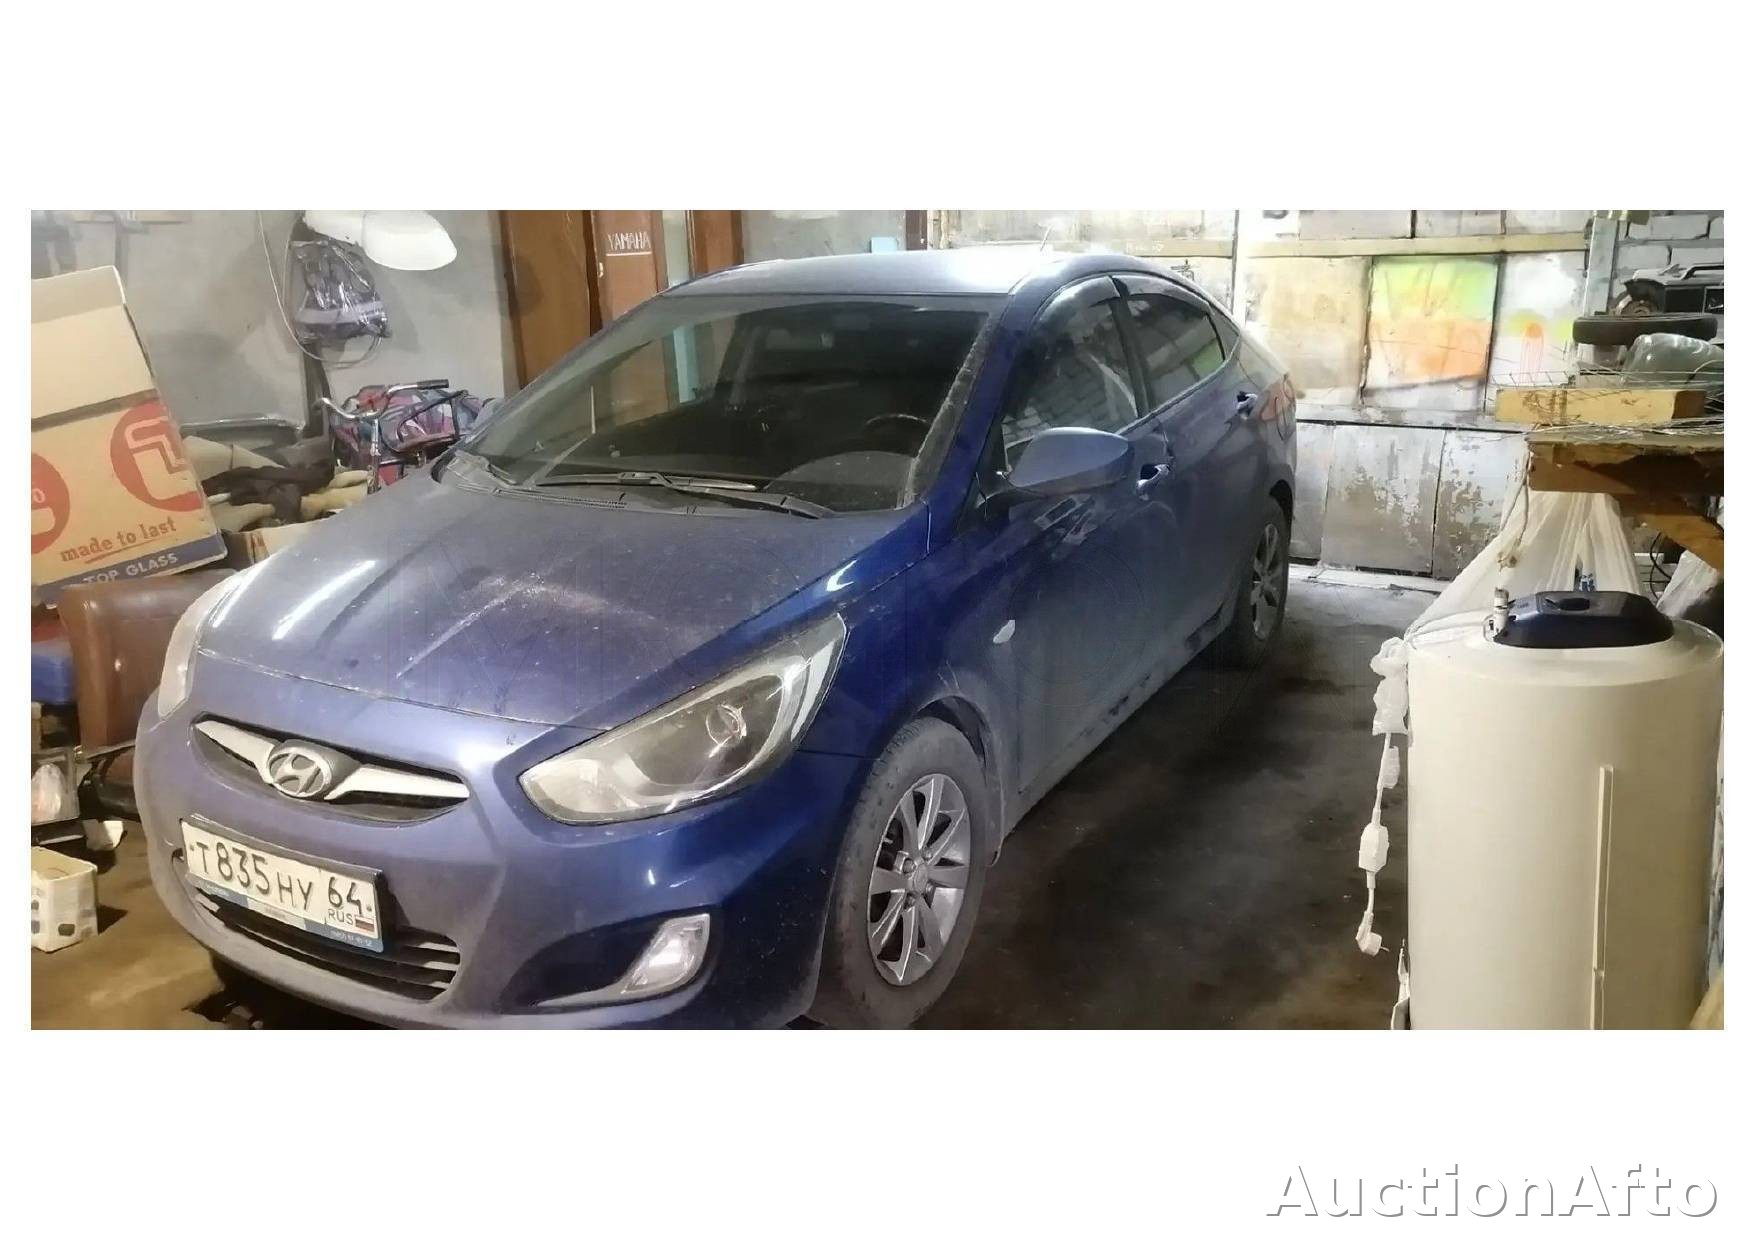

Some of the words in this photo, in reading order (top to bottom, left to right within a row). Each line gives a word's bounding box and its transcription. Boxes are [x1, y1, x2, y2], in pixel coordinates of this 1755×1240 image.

[607, 231, 652, 251] YAMAHA
[60, 537, 113, 562] made
[116, 529, 137, 547] to
[139, 516, 177, 540] last
[83, 569, 120, 584] TOP
[125, 552, 178, 577] GLASS
[327, 876, 363, 915] 64
[327, 908, 354, 926] RUS
